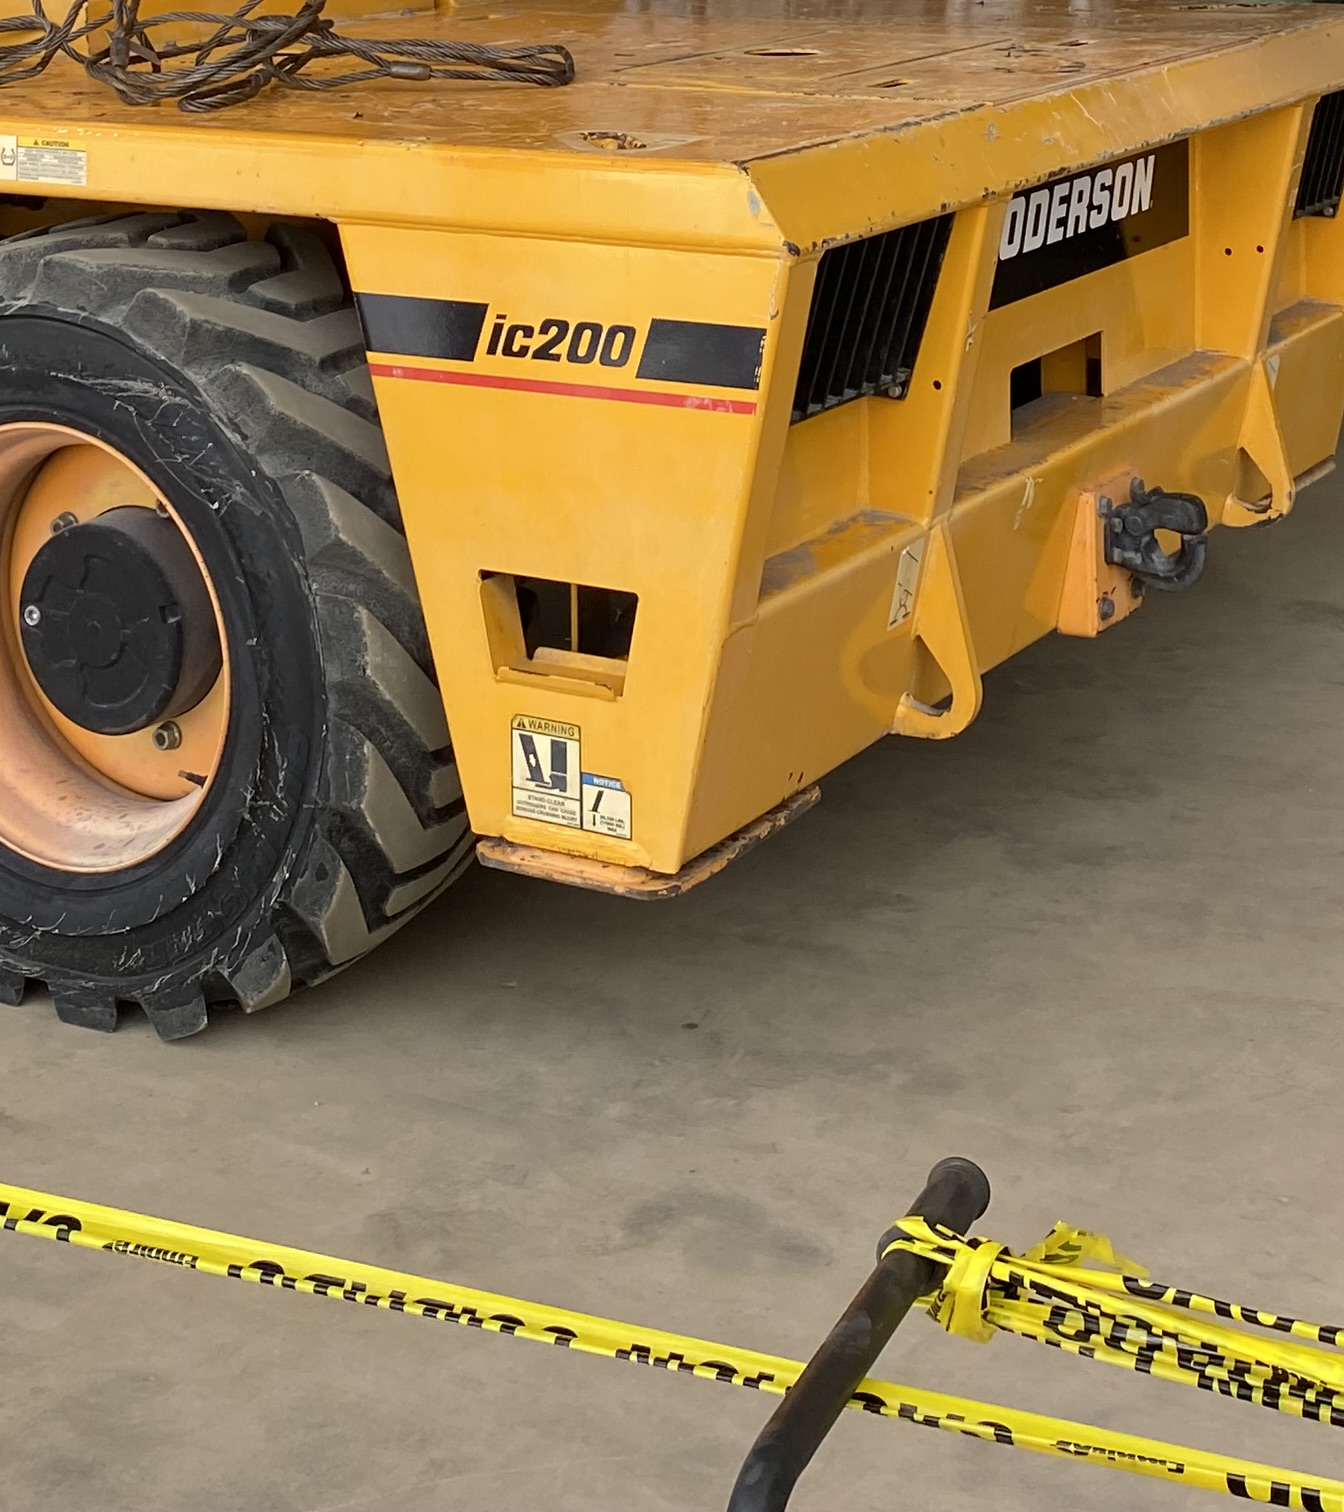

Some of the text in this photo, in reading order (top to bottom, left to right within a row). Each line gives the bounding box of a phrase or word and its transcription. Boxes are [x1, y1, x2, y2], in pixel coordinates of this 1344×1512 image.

[41, 139, 70, 148] CAUTION
[999, 154, 1156, 260] ODERSON
[486, 313, 637, 368] ic200
[527, 718, 576, 738] WARNING
[592, 776, 622, 790] NOTICE
